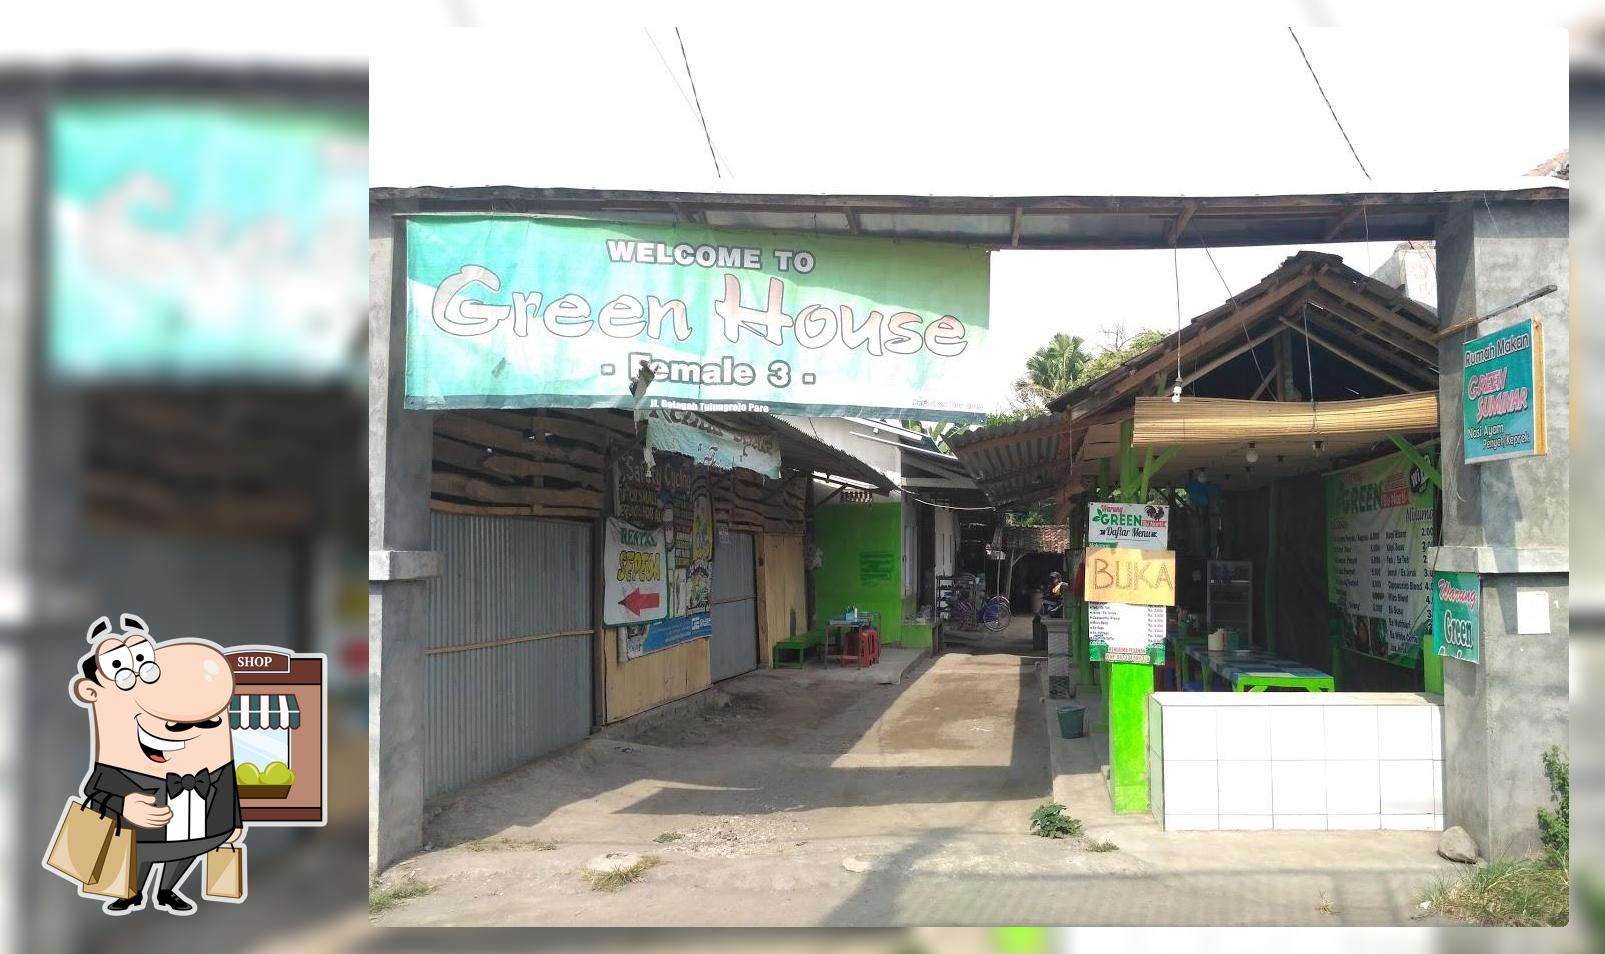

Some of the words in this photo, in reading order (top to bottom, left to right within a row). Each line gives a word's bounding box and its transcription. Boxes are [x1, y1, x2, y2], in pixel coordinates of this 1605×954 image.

[606, 238, 763, 271] WELCOME
[773, 246, 817, 274] TO
[431, 264, 694, 342] Green
[713, 272, 969, 358] House
[1465, 344, 1496, 368] Rumah
[1497, 333, 1530, 357] Makan
[628, 352, 757, 386] Female
[767, 359, 792, 389] 3
[1468, 366, 1508, 401] GREEN
[748, 403, 770, 413] Pare
[1468, 428, 1482, 440] Nasi
[1483, 423, 1505, 437] Ayam
[1100, 513, 1142, 527] GREEN
[1094, 558, 1174, 590] BUKA
[1438, 579, 1477, 613] Warung
[1444, 609, 1472, 649] Green
